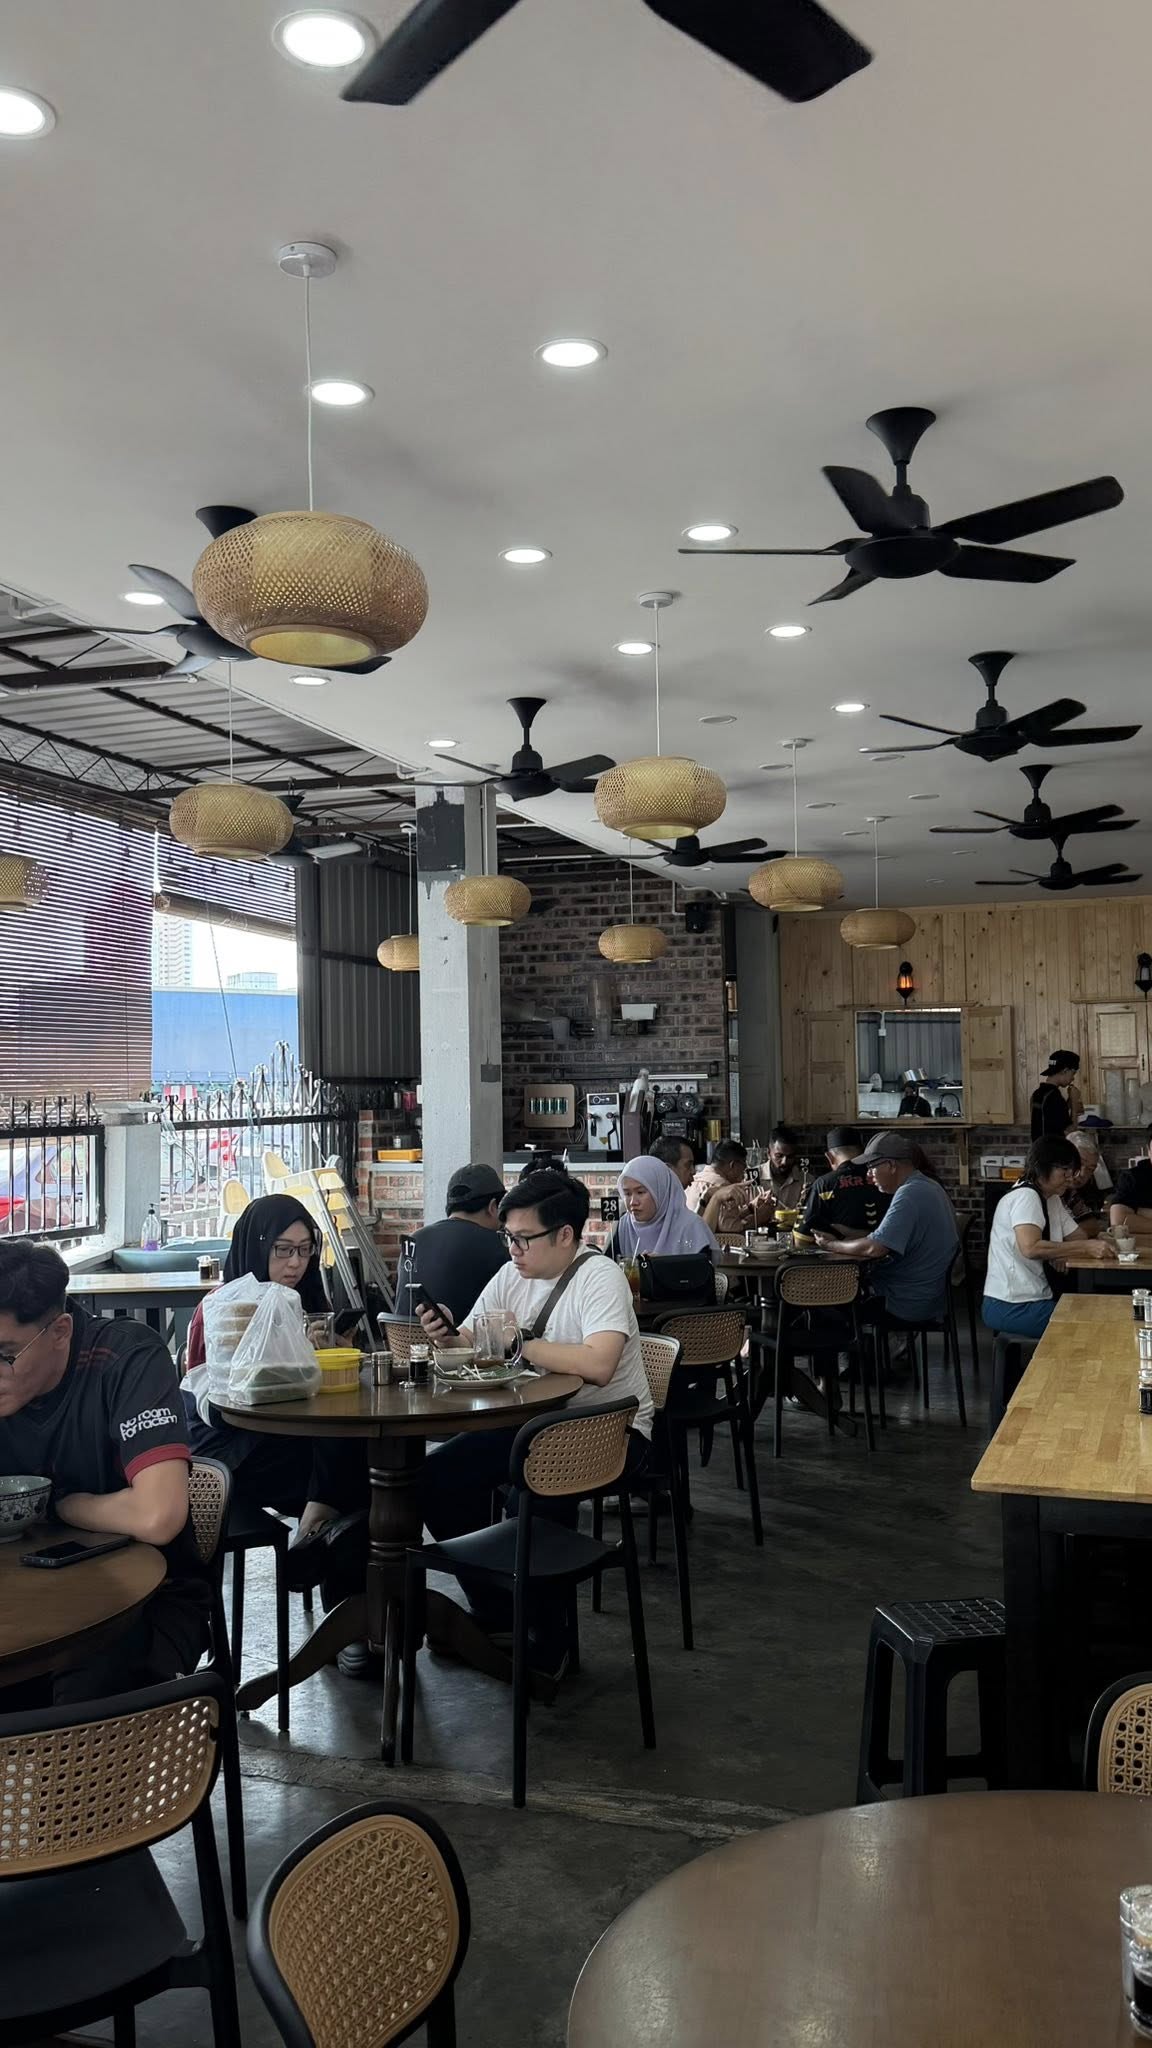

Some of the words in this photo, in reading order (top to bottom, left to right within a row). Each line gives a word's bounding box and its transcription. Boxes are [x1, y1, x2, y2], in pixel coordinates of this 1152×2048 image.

[800, 1158, 810, 1167] 29
[749, 1170, 759, 1180] 19
[603, 1200, 617, 1212] 28
[404, 1240, 416, 1258] 17
[120, 1417, 137, 1430] No
[138, 1408, 171, 1421] room
[138, 1415, 178, 1430] racism
